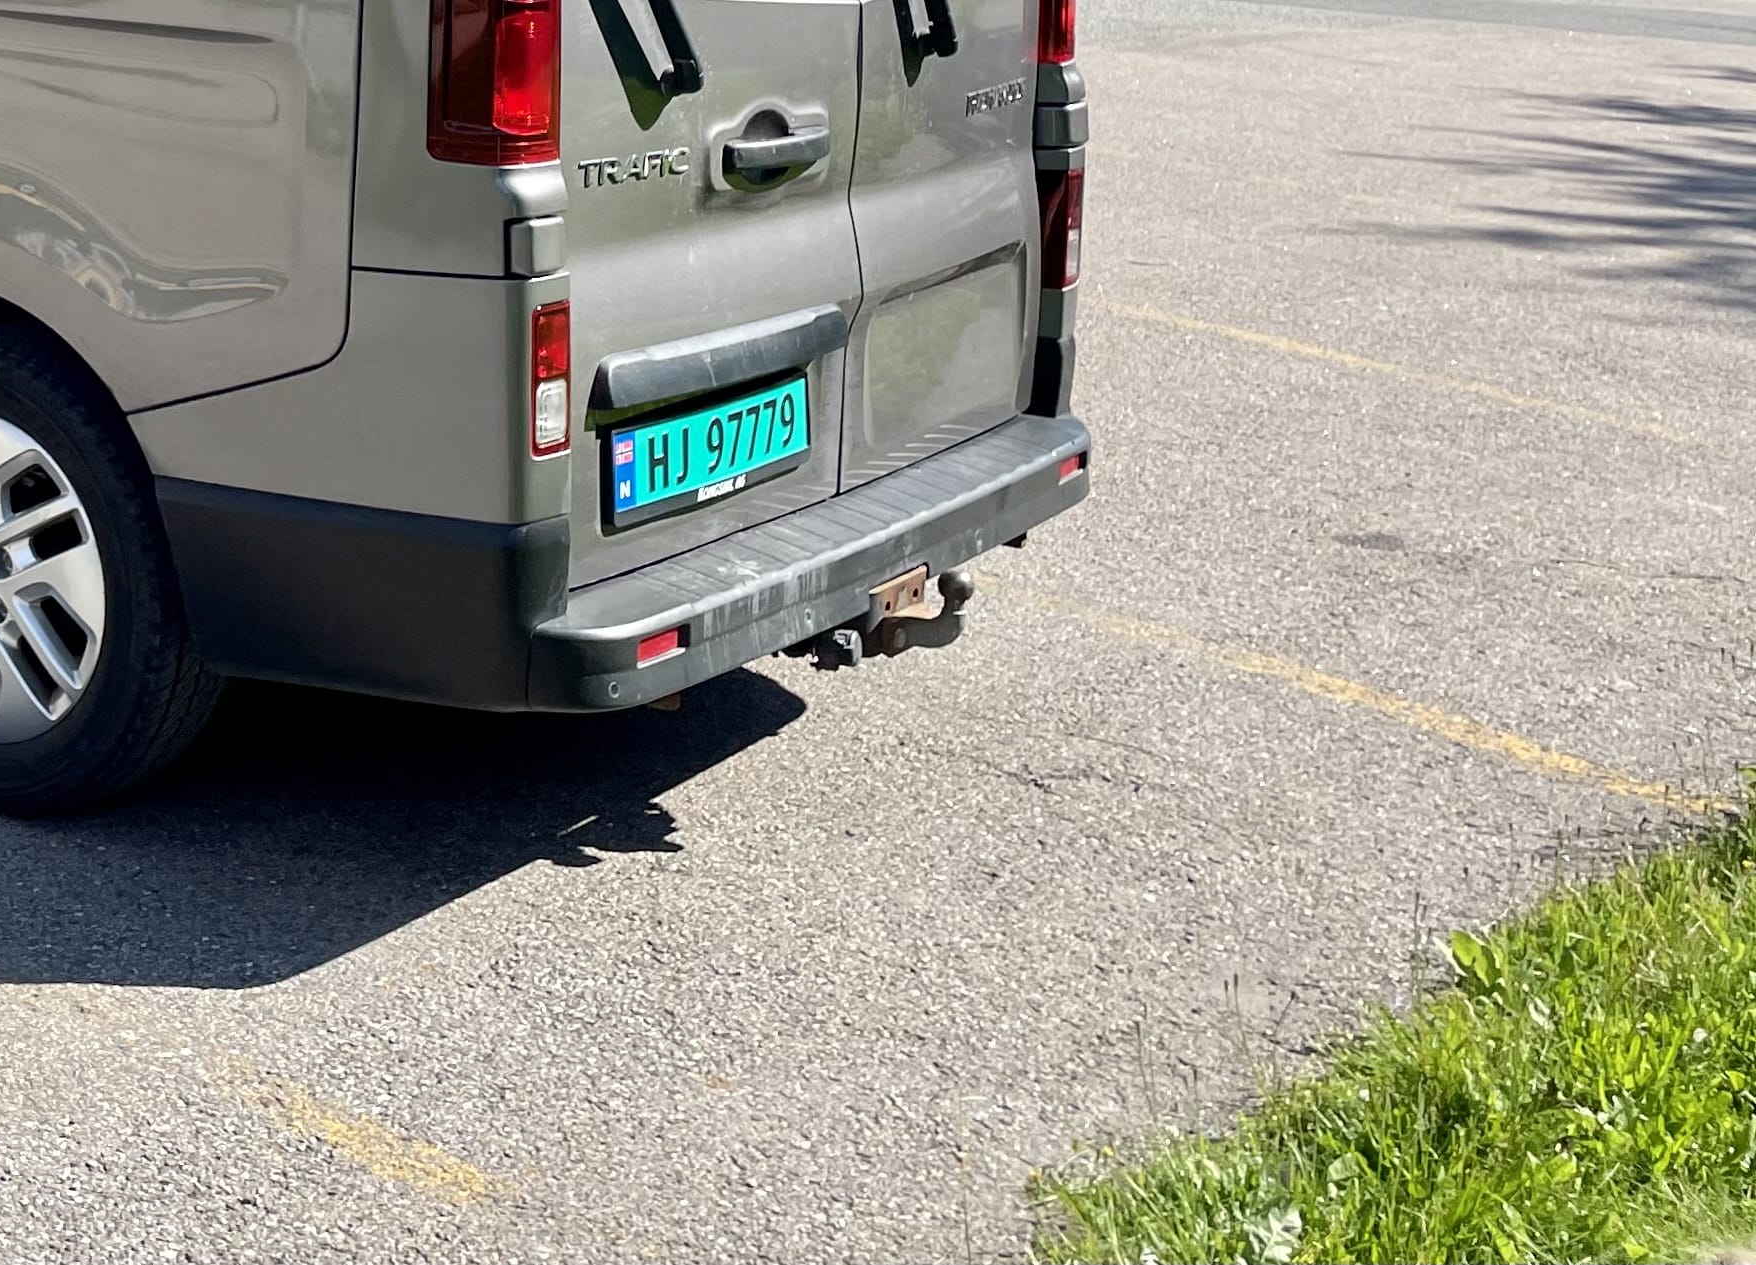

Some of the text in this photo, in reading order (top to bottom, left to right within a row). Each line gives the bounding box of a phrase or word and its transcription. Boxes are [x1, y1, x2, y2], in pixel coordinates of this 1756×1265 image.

[577, 147, 691, 188] TRAFIC
[647, 393, 794, 492] HJ 97779
[619, 479, 631, 500] N
